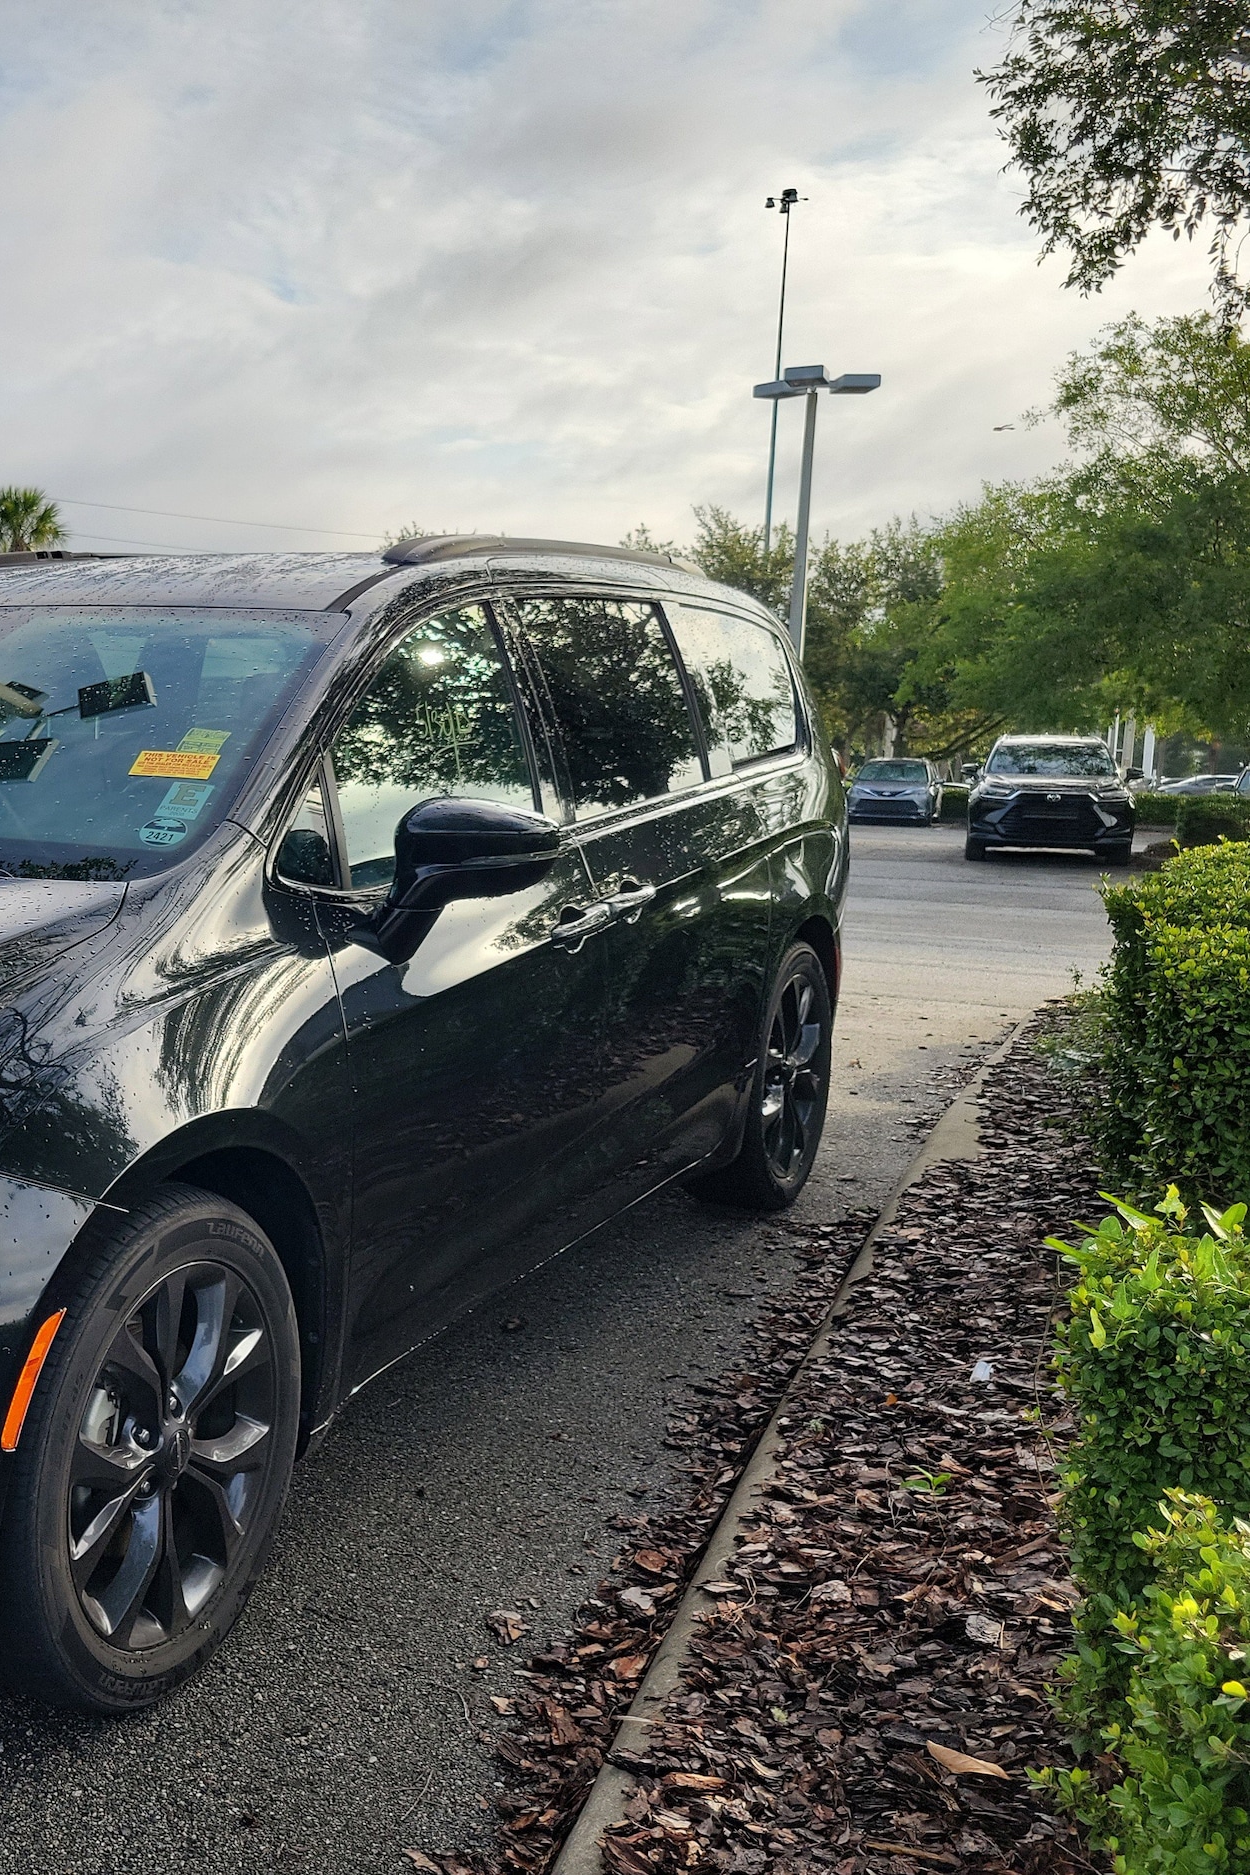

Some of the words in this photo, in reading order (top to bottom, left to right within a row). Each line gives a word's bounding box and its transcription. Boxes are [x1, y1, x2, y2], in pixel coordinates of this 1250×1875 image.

[169, 783, 207, 806] E
[160, 805, 198, 814] PARENTS
[146, 831, 174, 842] 2421
